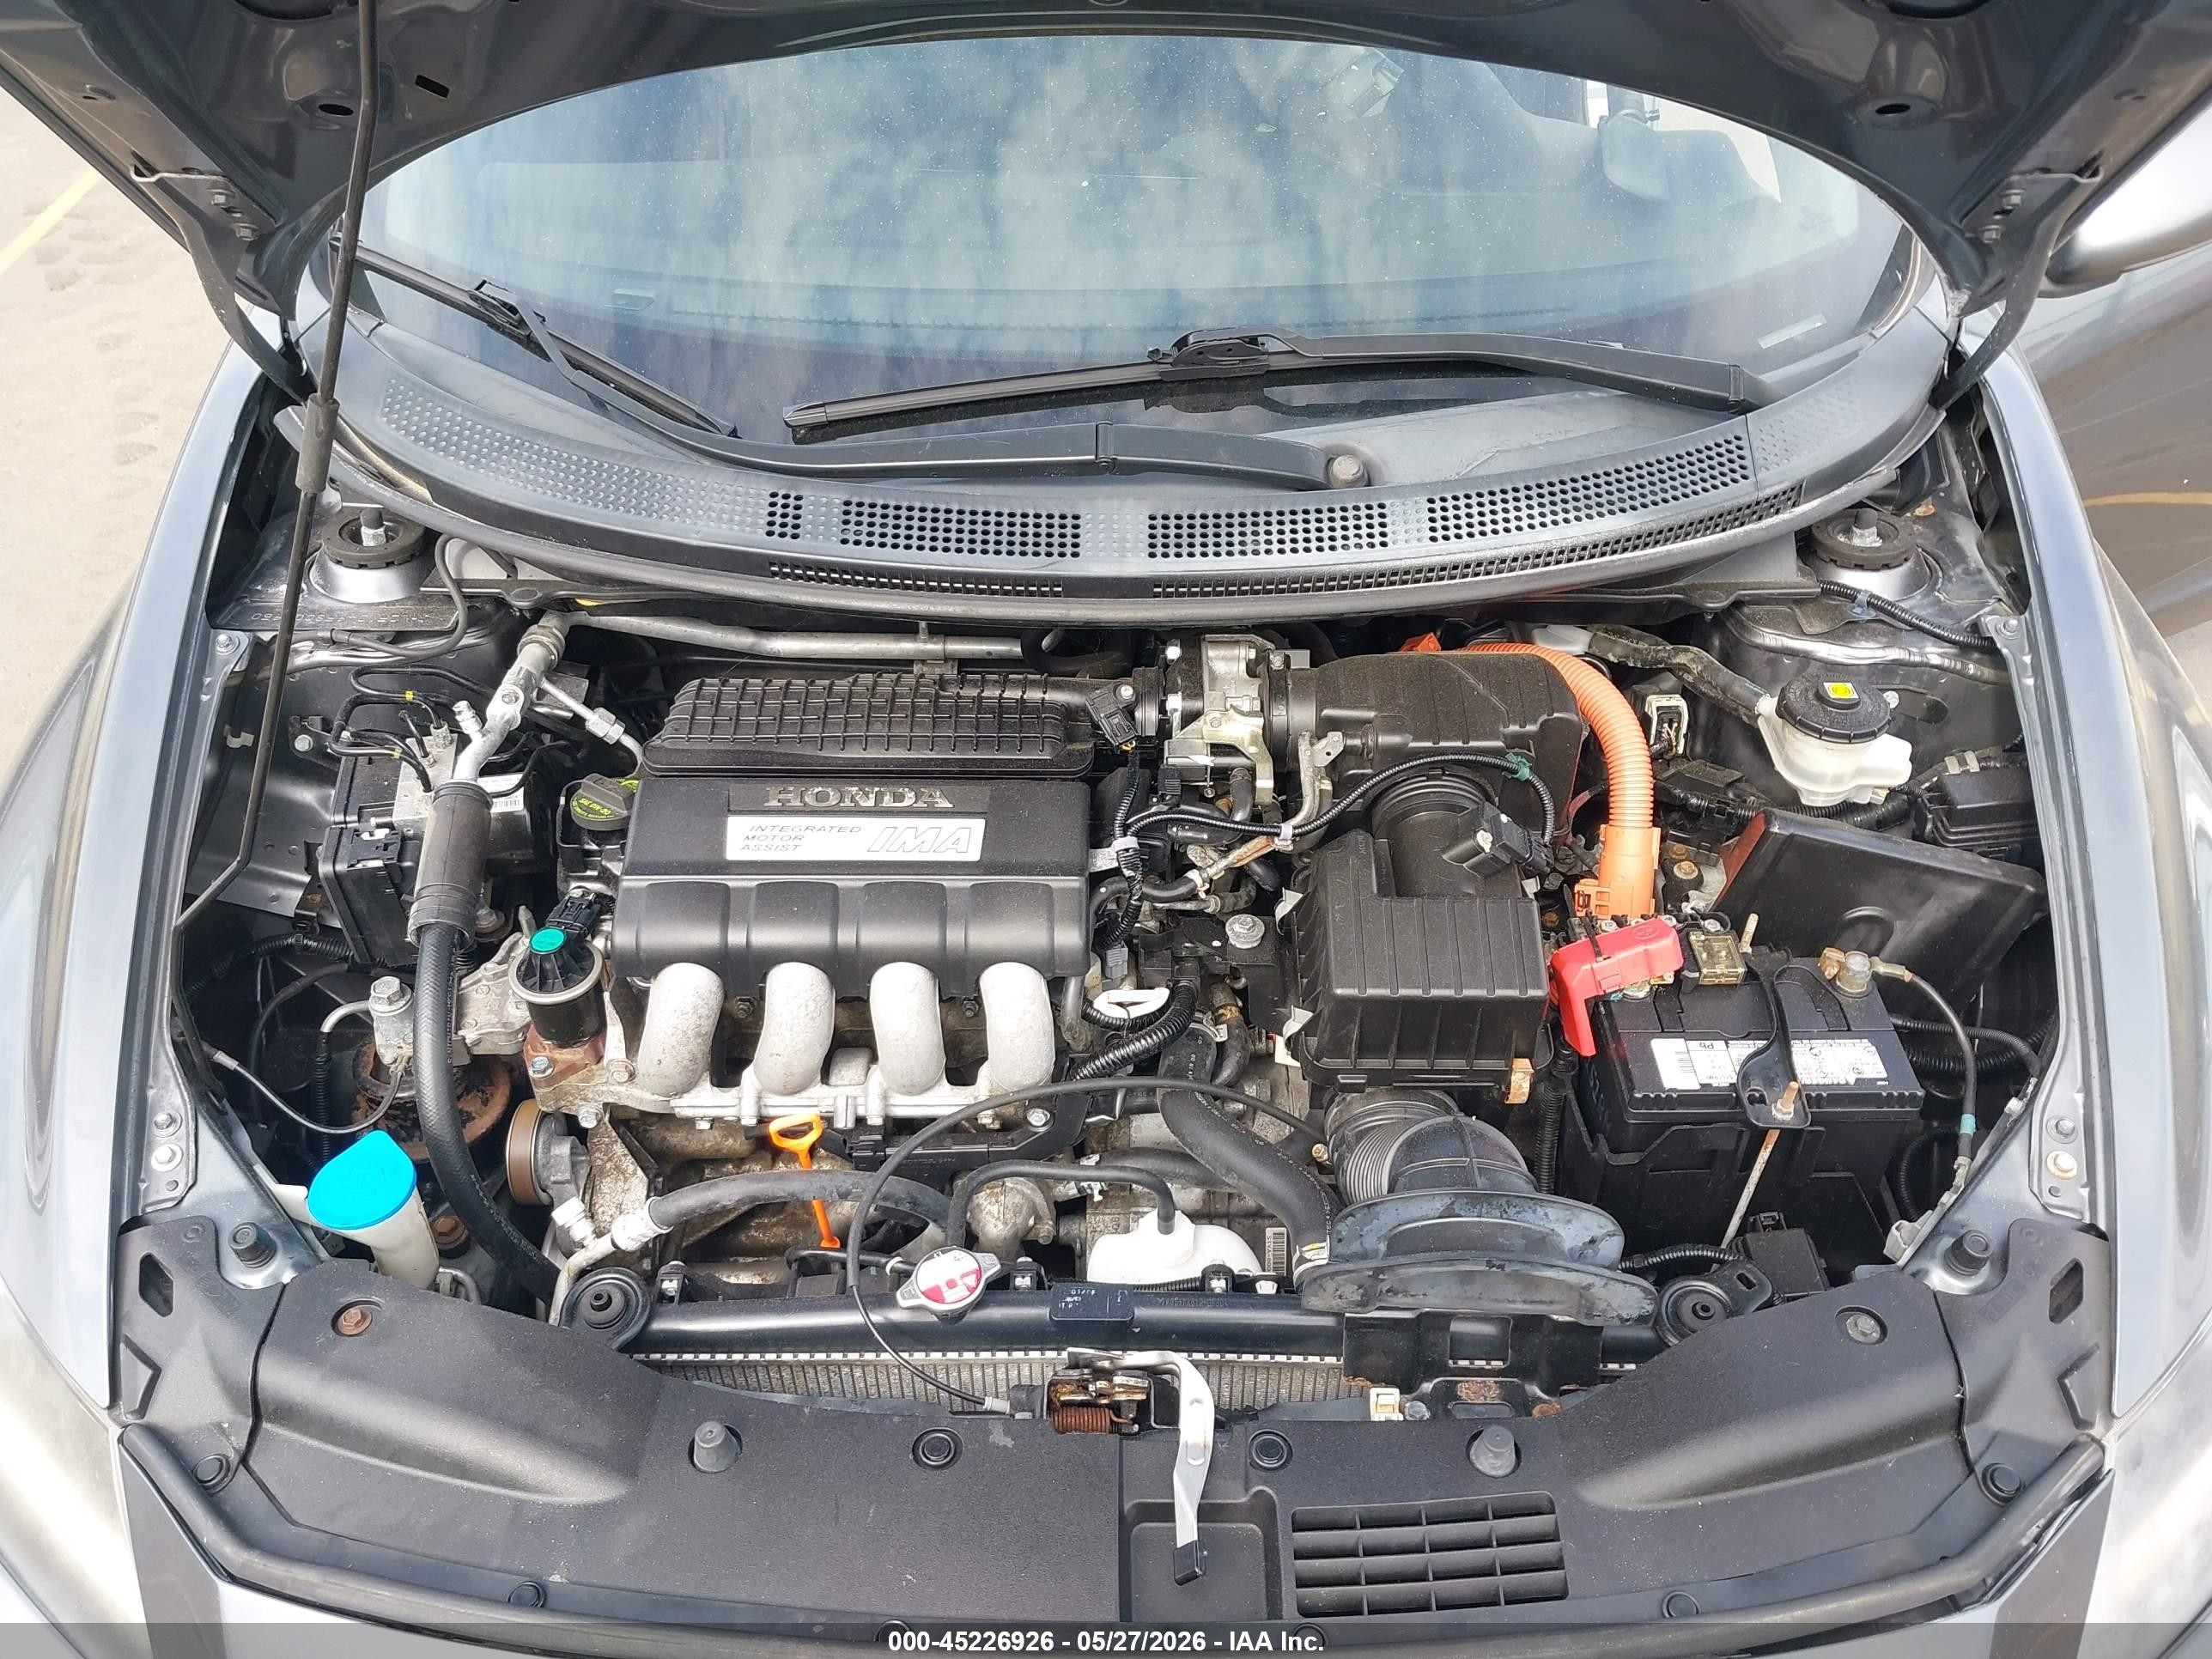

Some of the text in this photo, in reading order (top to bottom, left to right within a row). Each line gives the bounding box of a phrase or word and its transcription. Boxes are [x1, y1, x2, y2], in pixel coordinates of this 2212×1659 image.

[764, 786, 955, 808] HONDA
[749, 824, 862, 833] INTEGRATED
[739, 843, 802, 853] ASSIST
[866, 826, 972, 854] IMA
